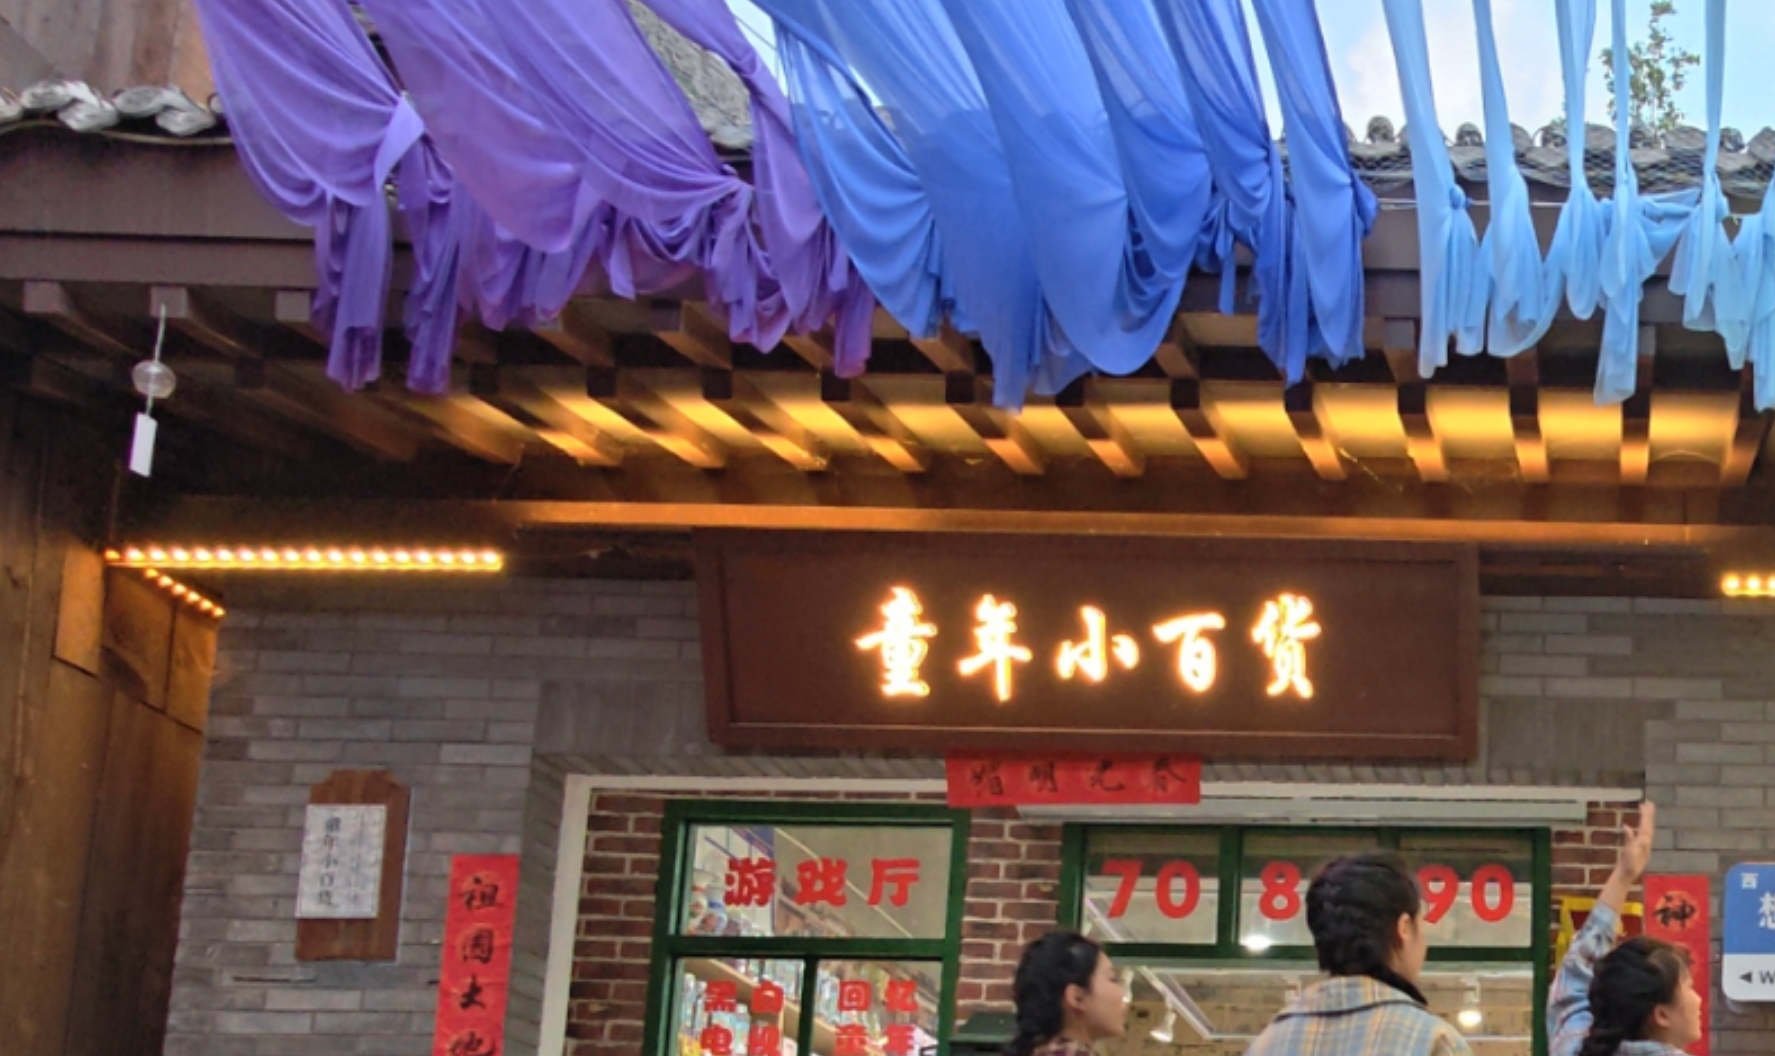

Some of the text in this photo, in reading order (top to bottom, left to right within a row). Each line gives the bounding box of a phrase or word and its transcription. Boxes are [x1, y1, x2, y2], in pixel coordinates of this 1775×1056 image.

[853, 584, 1322, 702] 童年小百货
[723, 857, 921, 907] 游戏厅
[1101, 860, 1201, 919] 70
[1416, 863, 1515, 925] 90
[1741, 873, 1758, 889] 西
[838, 980, 919, 1012] 回忆
